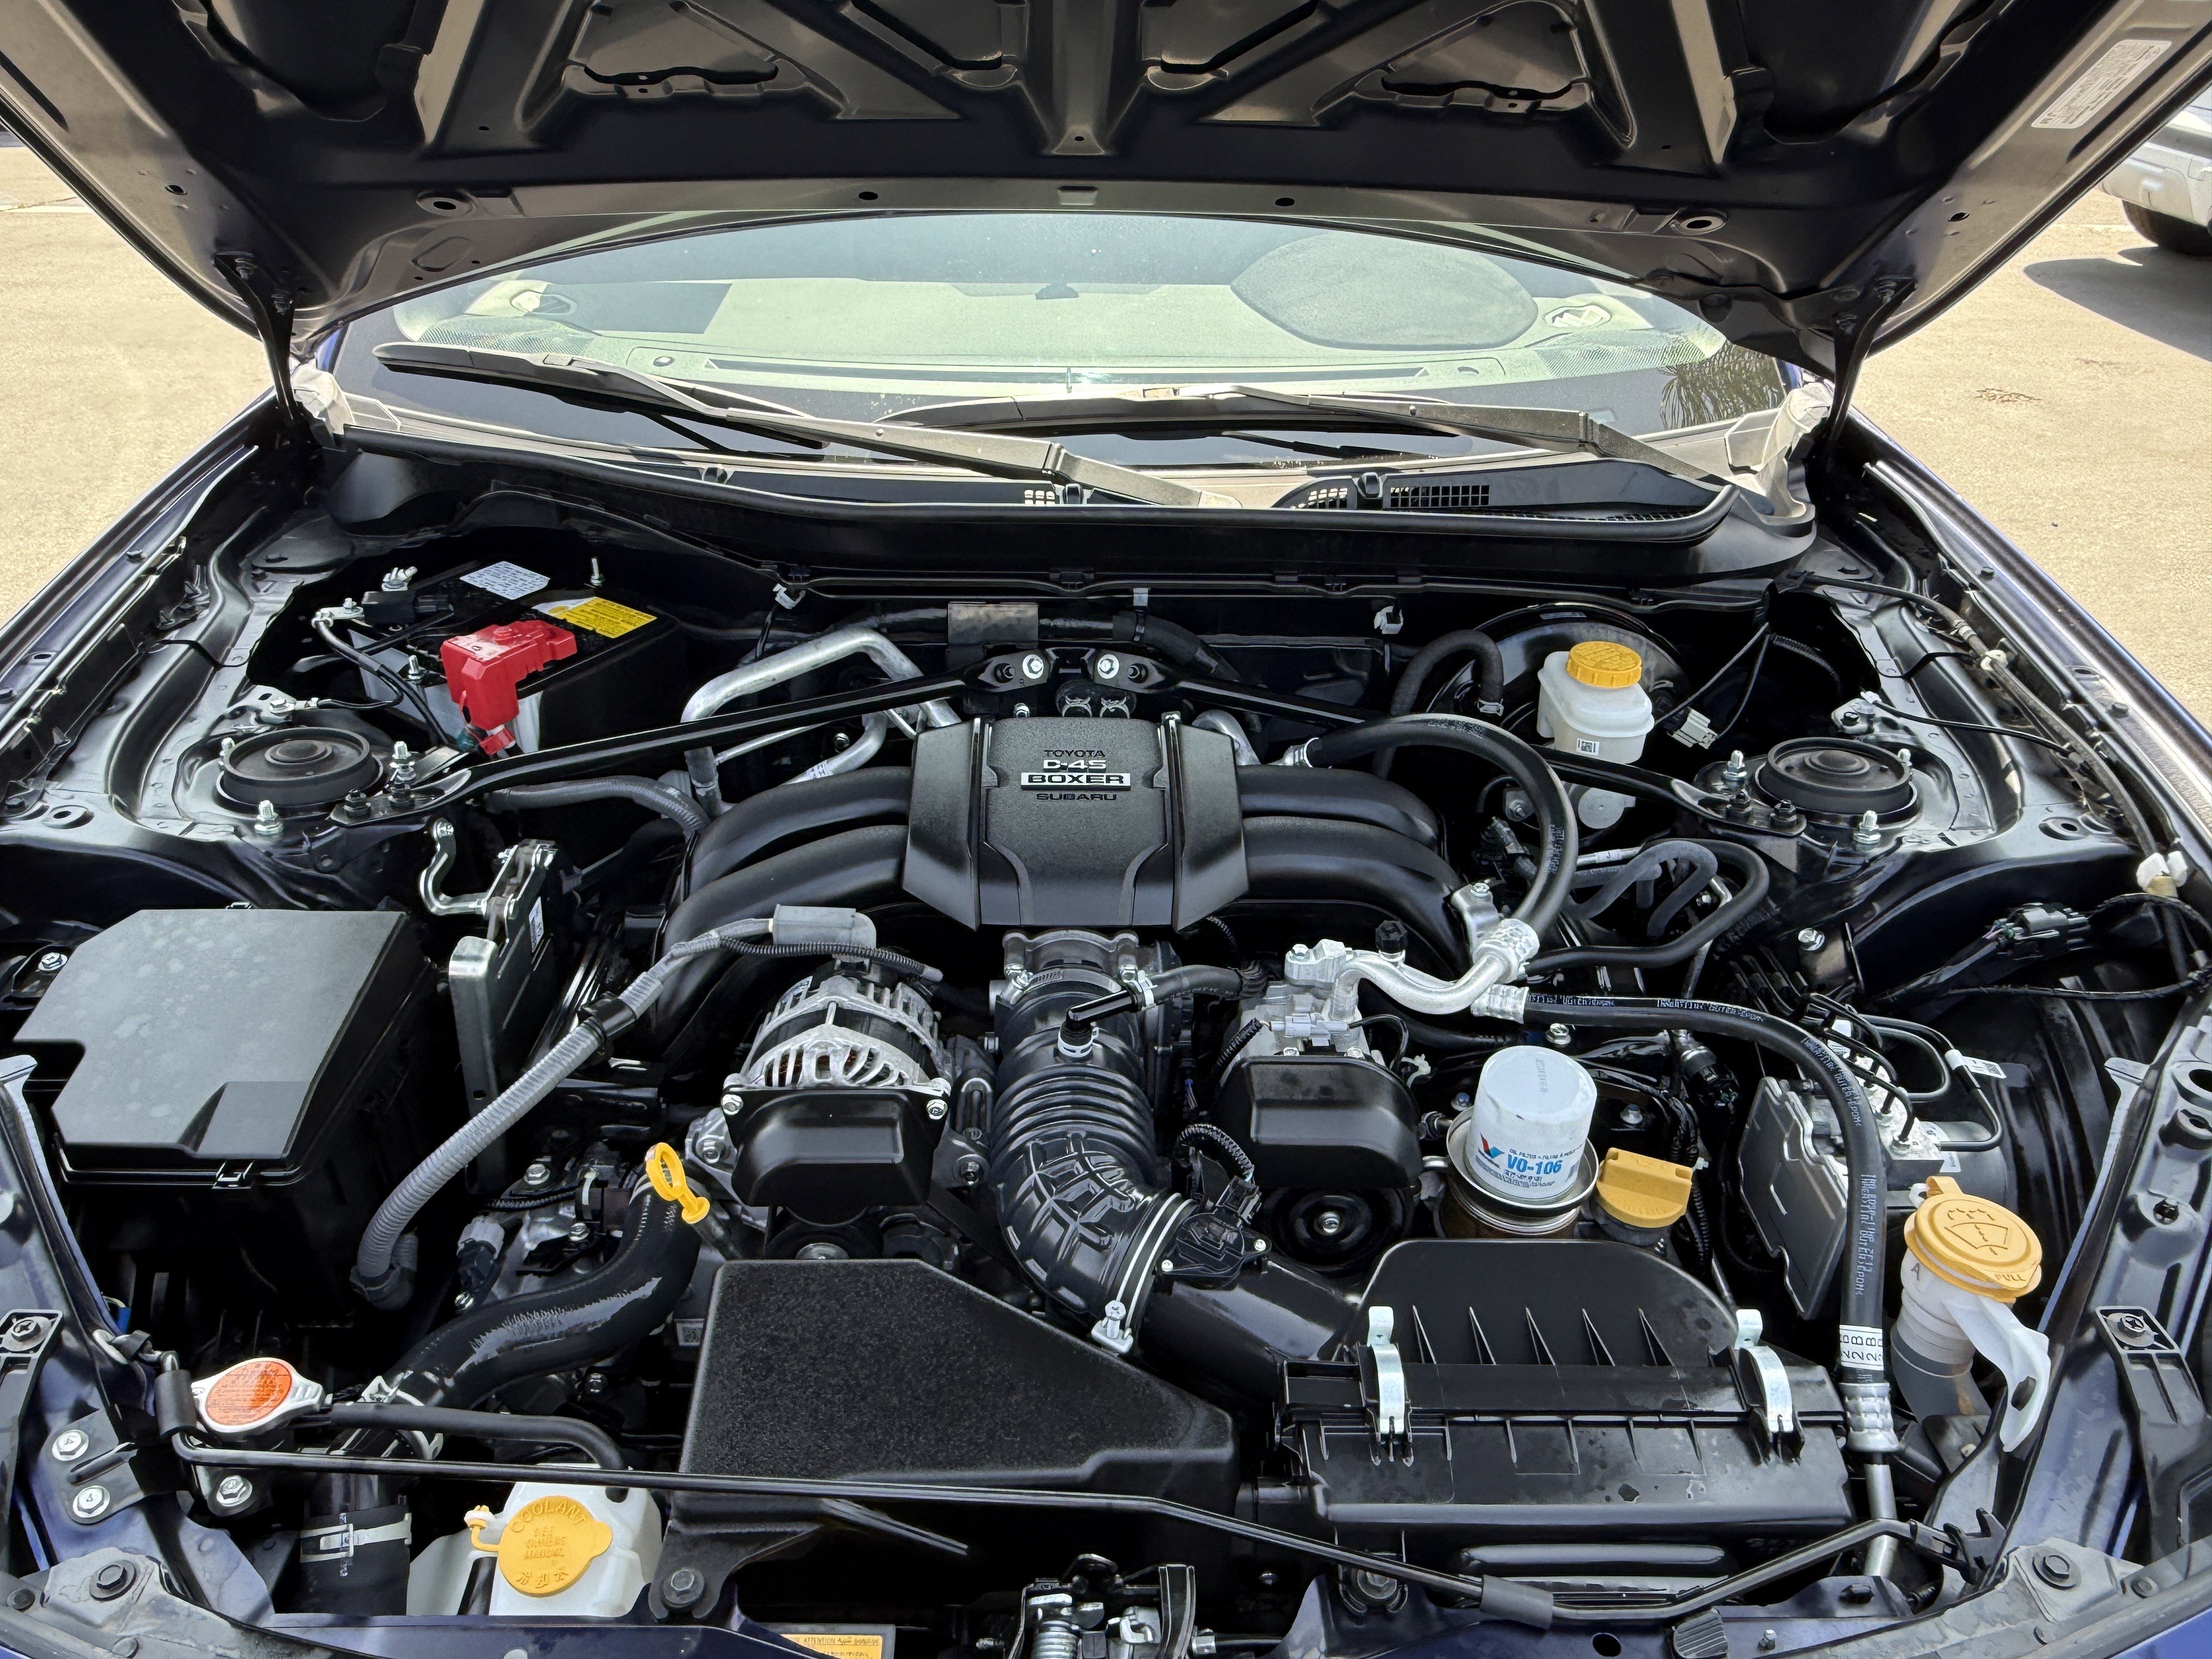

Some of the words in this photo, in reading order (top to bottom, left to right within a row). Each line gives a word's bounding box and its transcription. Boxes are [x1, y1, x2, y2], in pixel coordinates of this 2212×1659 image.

[1043, 759, 1107, 771] D-4S
[1028, 774, 1124, 785] BOXER
[1507, 1154, 1563, 1175] VO-106
[510, 1500, 588, 1533] COOLANT
